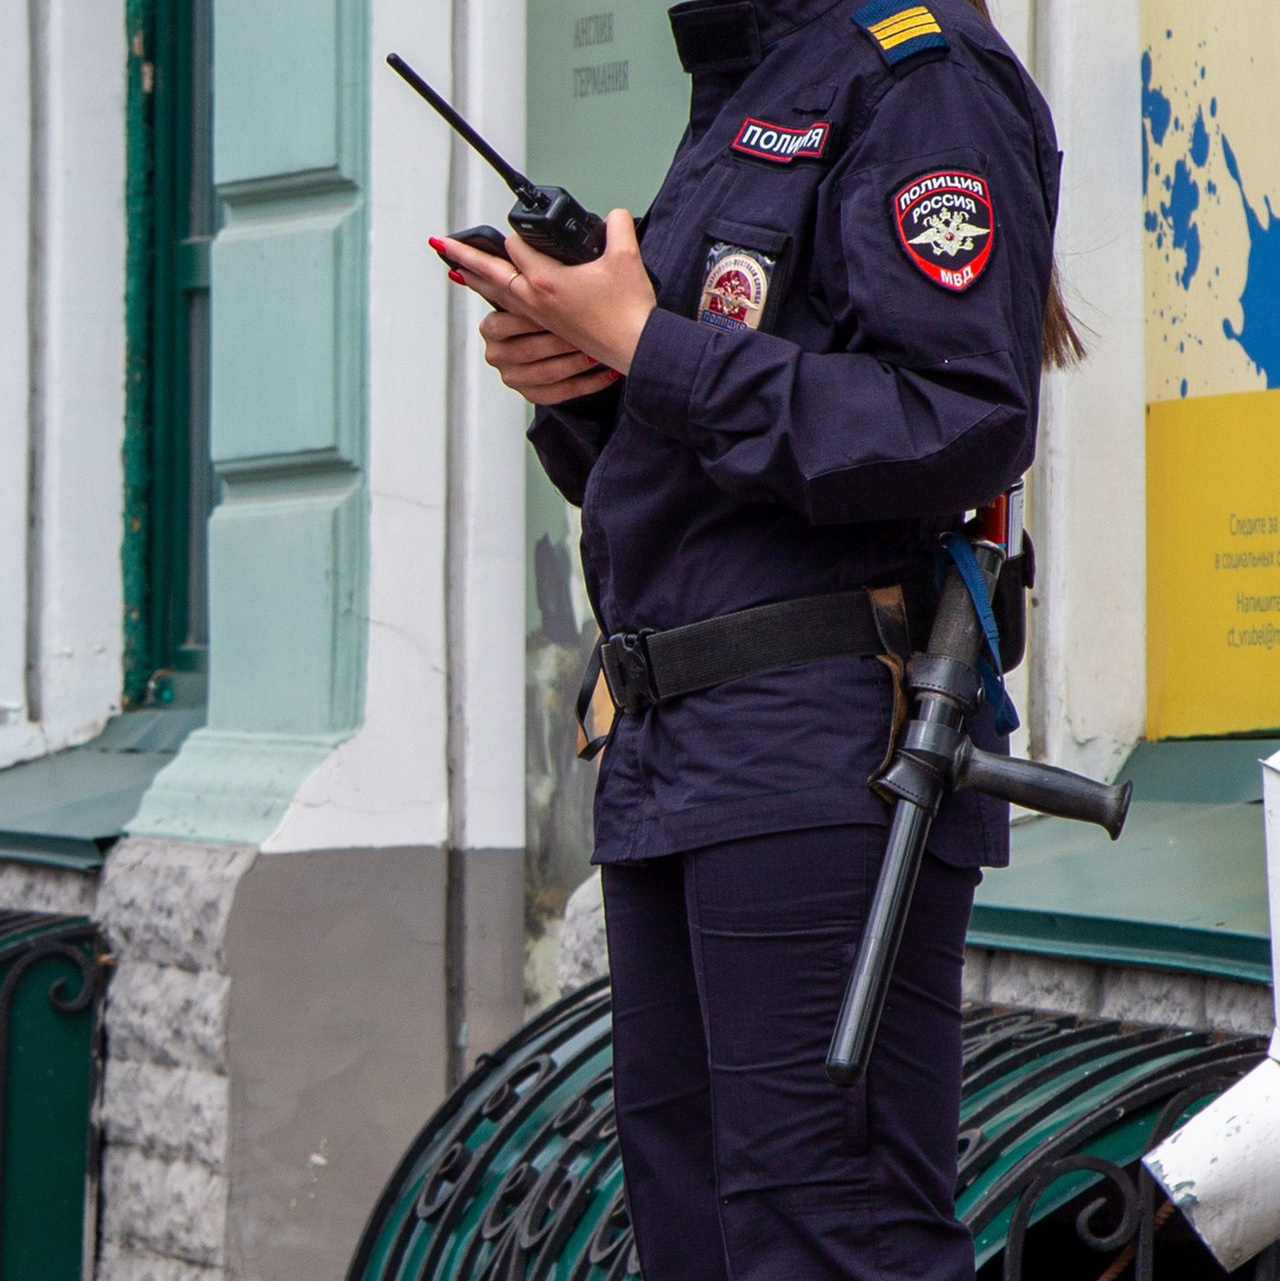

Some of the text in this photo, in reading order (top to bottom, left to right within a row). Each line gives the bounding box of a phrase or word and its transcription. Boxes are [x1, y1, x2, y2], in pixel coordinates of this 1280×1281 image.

[900, 176, 983, 210] ПОЛИЦИЯ
[912, 194, 976, 224] РОССИЯ
[940, 266, 974, 287] МВД
[1222, 551, 1274, 571] социальных
